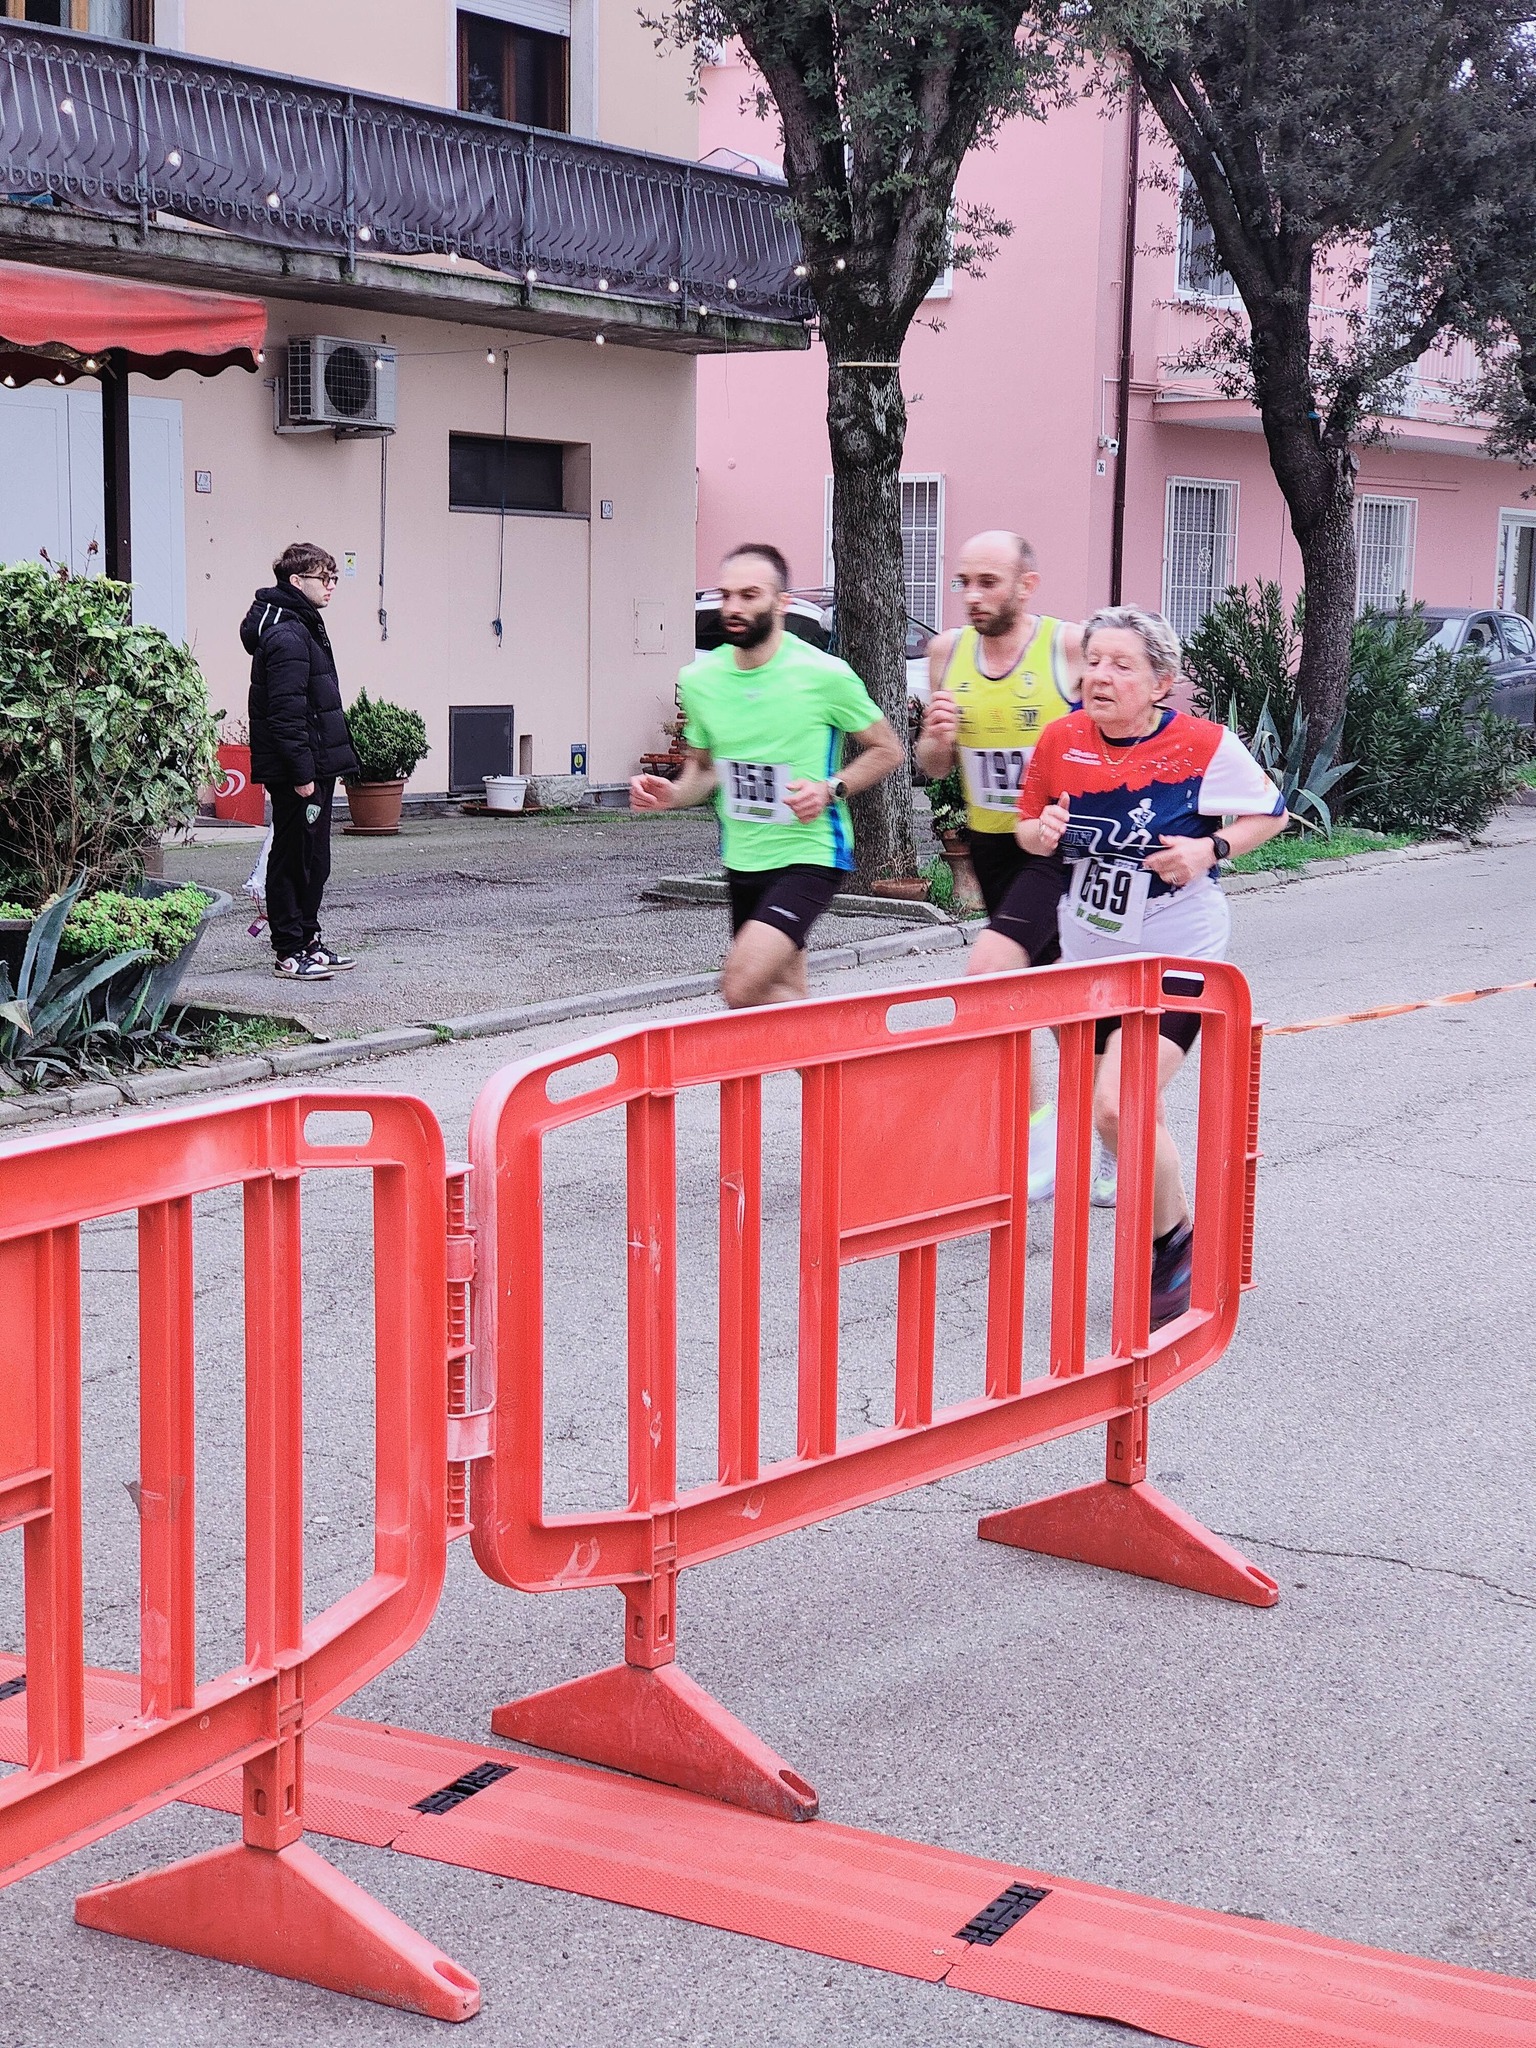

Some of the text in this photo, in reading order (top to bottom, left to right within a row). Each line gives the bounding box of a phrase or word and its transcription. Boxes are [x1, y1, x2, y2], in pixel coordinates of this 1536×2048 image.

[974, 751, 1026, 790] 192
[1226, 1962, 1398, 2008] RACE RESULT
